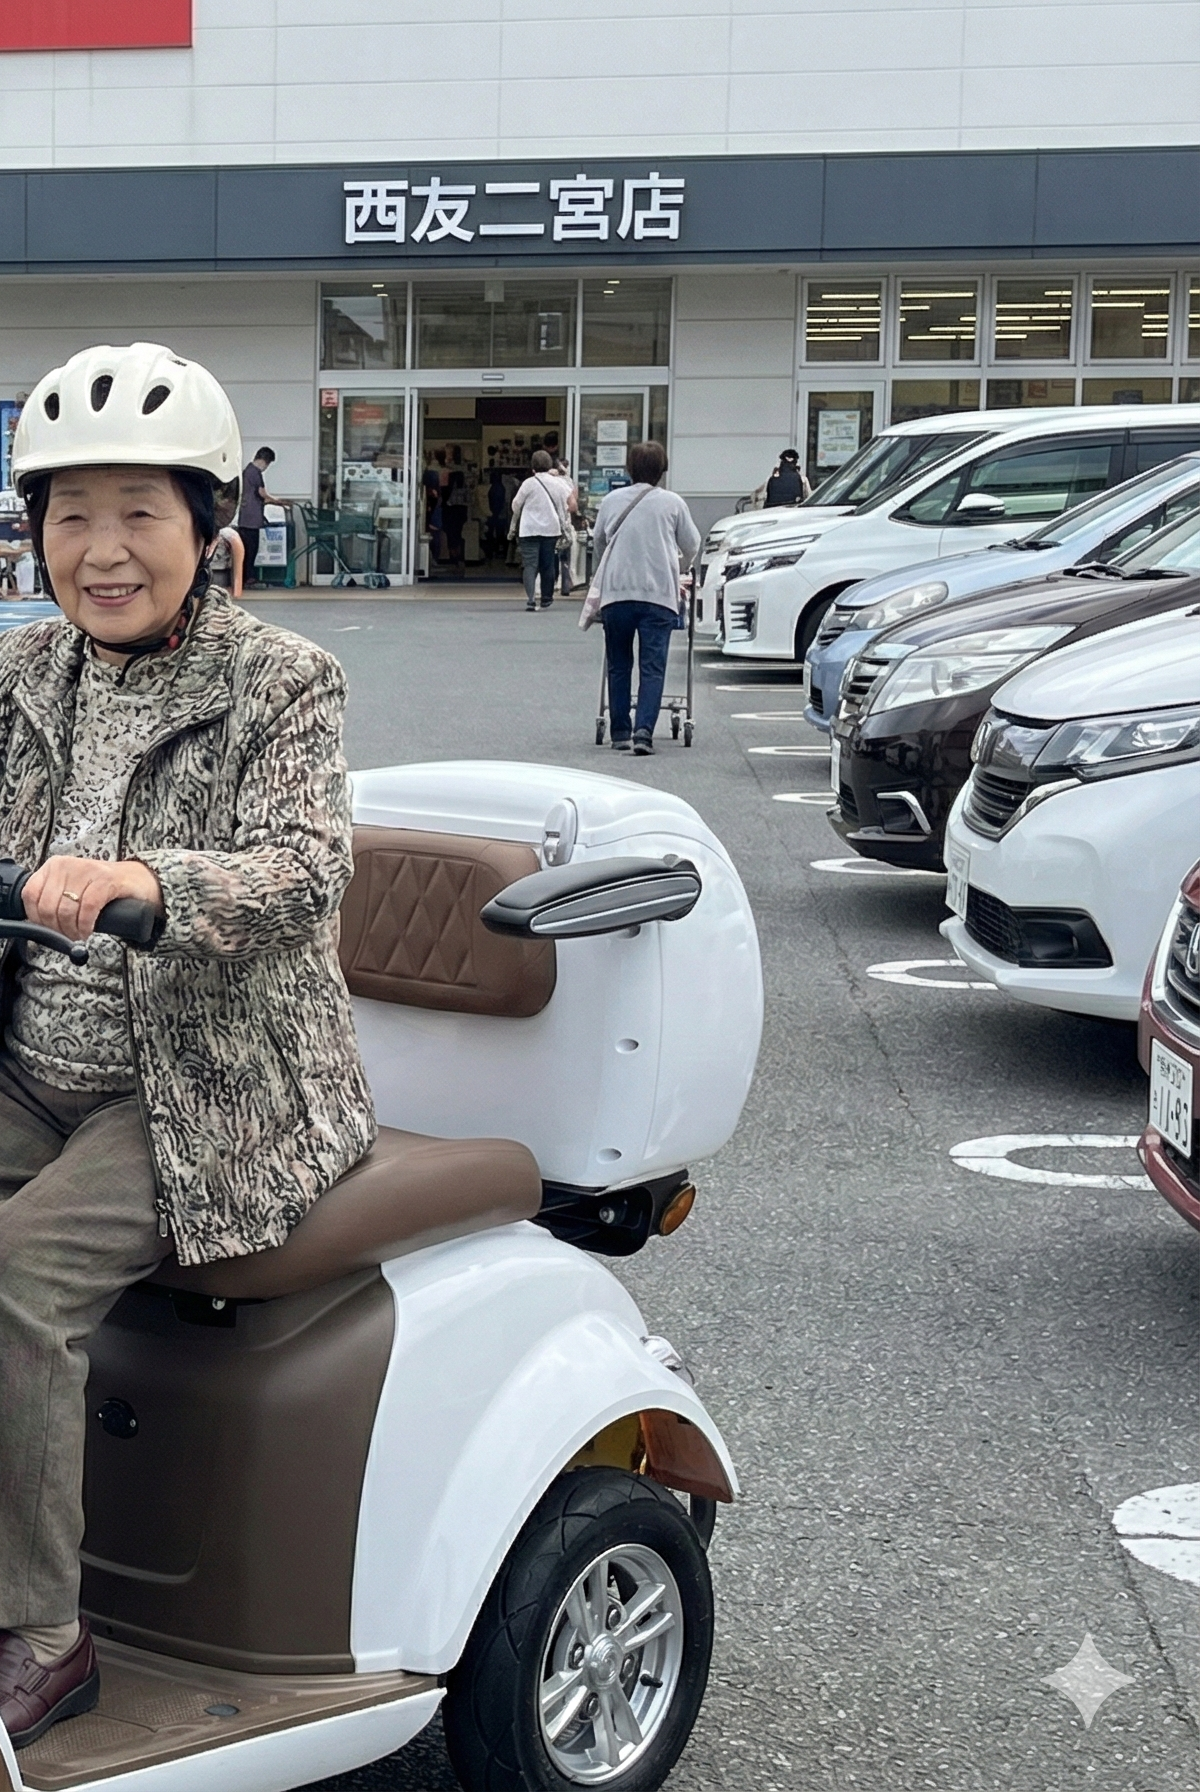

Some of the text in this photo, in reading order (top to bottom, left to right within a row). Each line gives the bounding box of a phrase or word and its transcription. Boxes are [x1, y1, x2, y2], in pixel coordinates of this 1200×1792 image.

[343, 172, 685, 245] 西友二宮店
